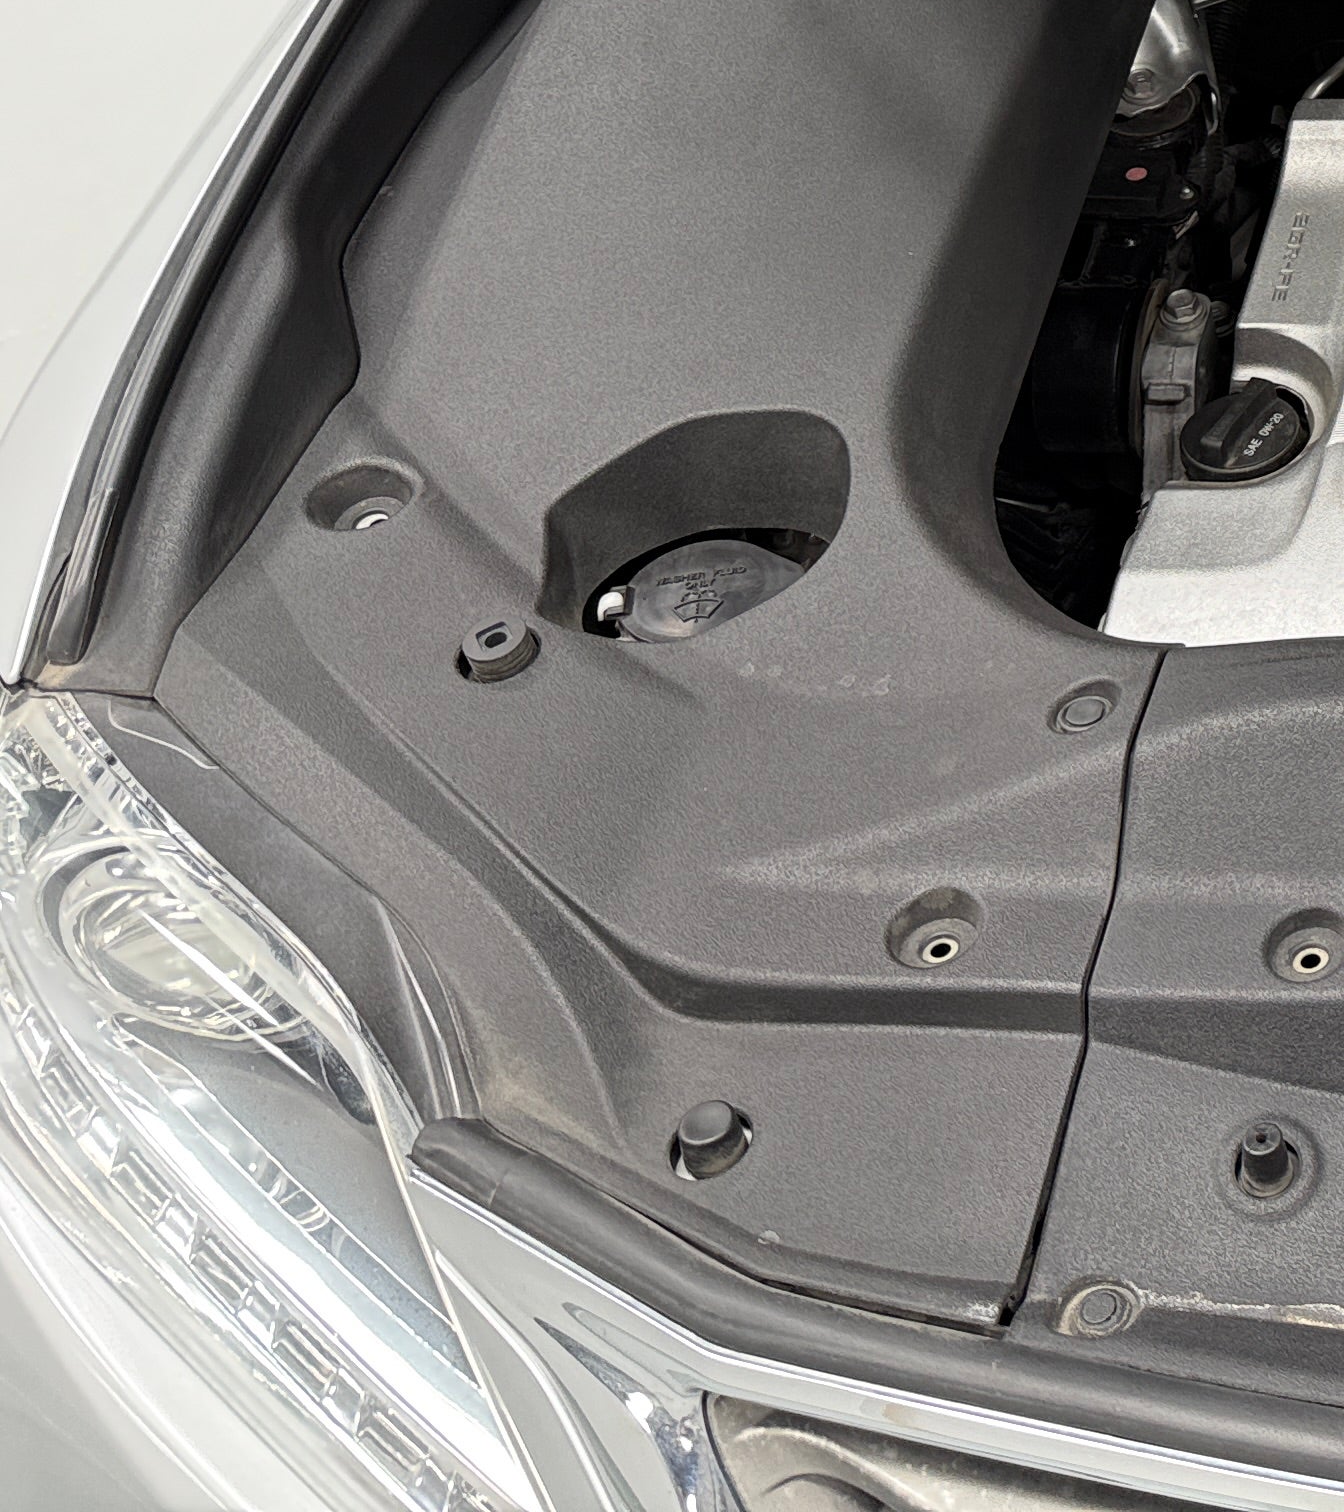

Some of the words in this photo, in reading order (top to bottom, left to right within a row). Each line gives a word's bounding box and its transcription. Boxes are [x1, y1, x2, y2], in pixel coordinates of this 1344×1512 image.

[1242, 437, 1264, 457] SAE
[1258, 412, 1285, 437] 0W-20
[655, 571, 706, 587] WASHER
[713, 566, 748, 578] FLUID
[684, 578, 717, 590] ONLY
